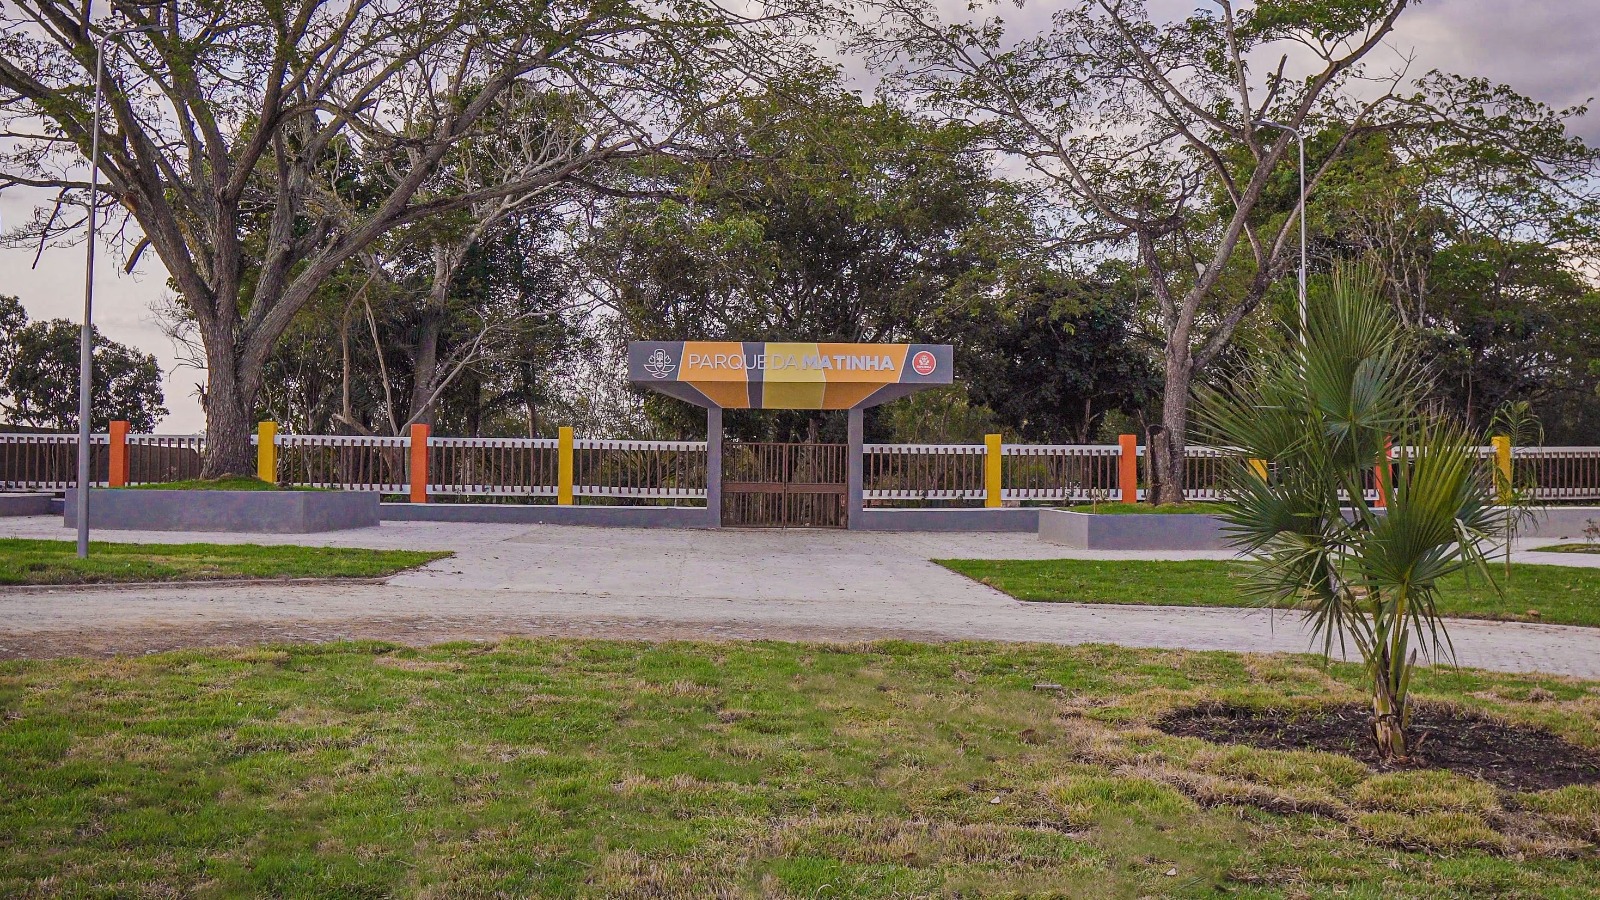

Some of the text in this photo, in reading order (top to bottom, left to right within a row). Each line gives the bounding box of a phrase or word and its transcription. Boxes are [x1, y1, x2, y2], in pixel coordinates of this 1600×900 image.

[689, 354, 895, 371] PARQUE DA MATINHA
